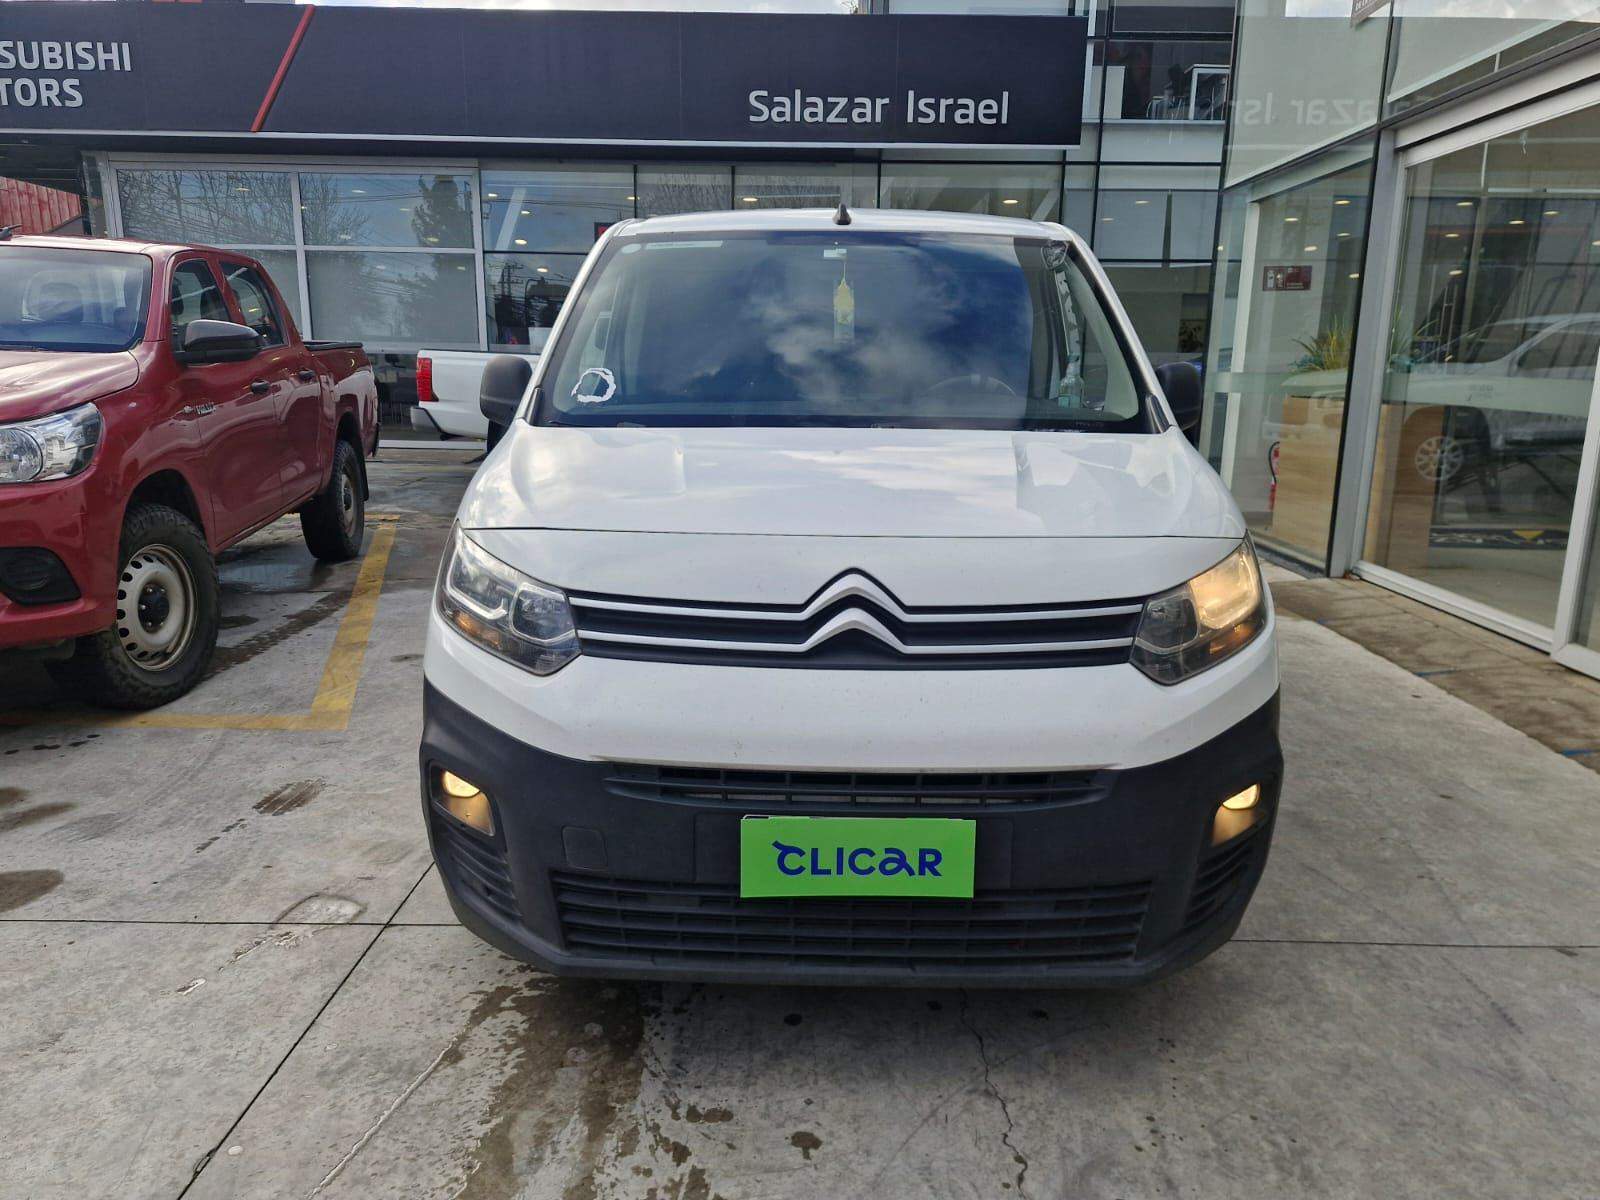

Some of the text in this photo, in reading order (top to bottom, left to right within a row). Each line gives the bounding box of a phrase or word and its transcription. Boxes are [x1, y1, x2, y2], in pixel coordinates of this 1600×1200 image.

[0, 40, 131, 71] SUBISHI
[748, 89, 1009, 124] Salazar Israel
